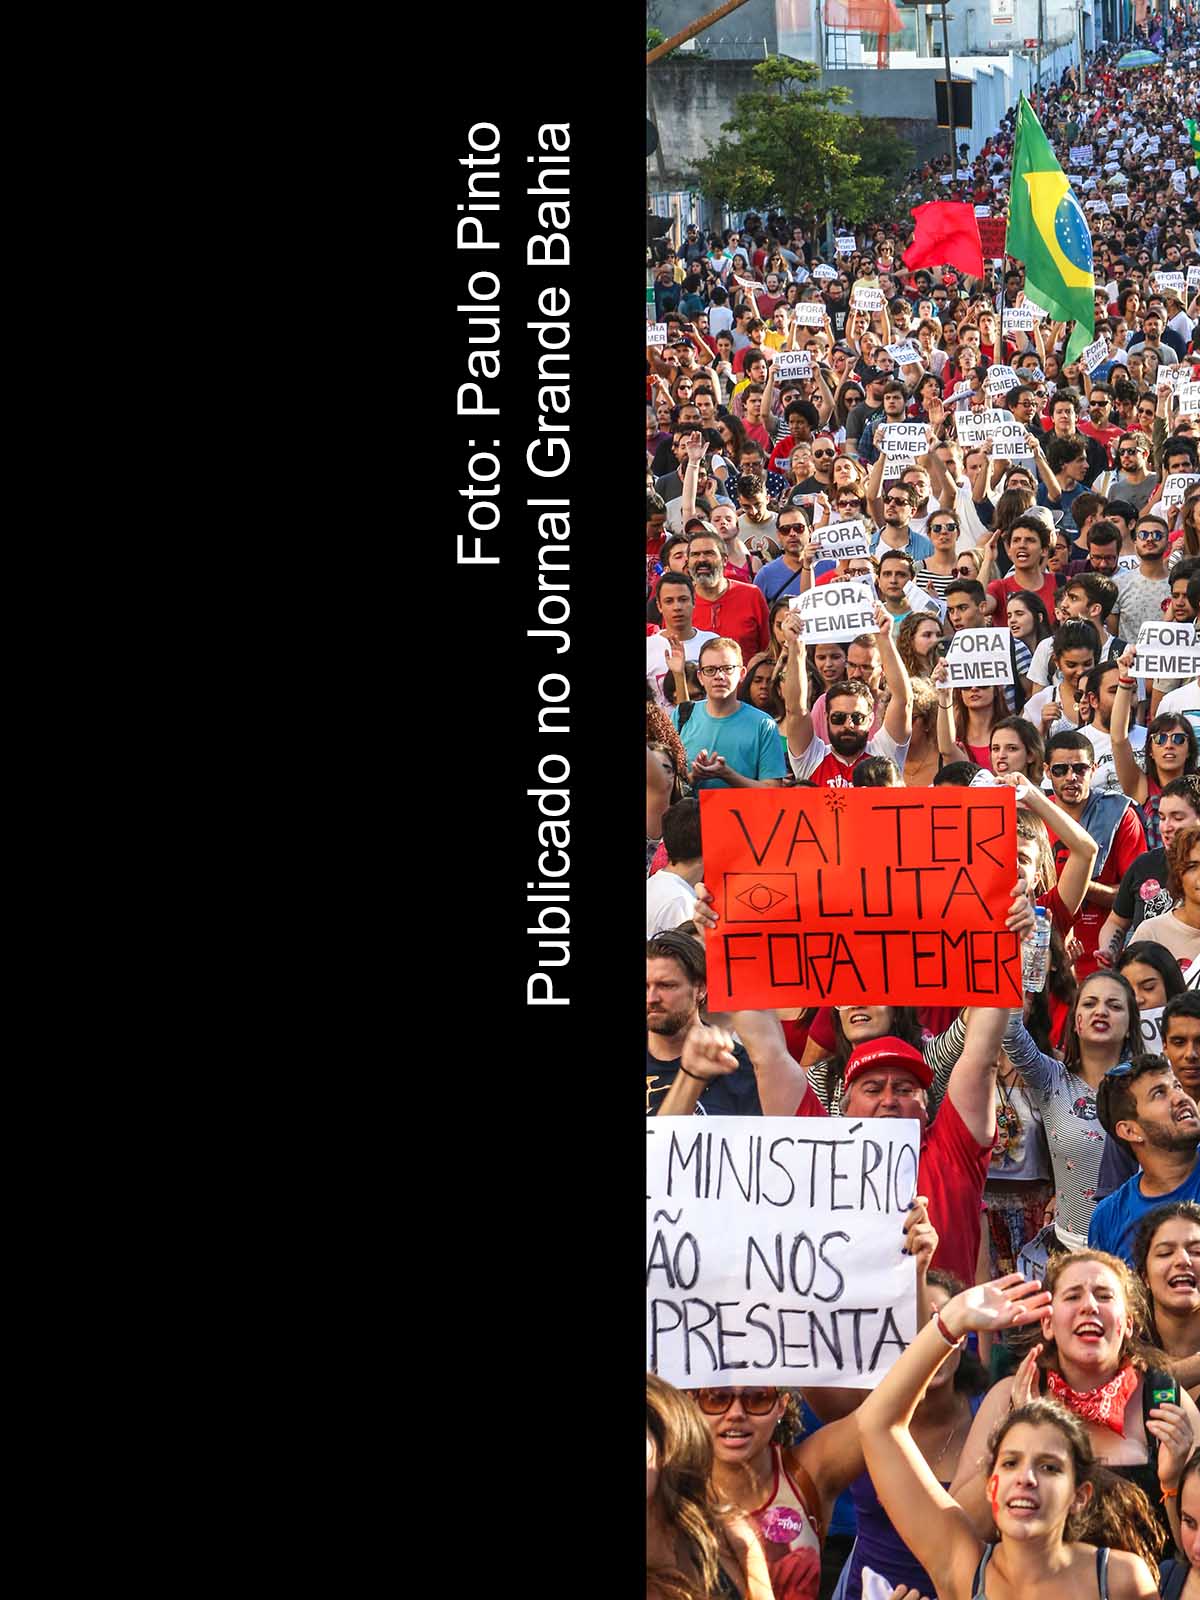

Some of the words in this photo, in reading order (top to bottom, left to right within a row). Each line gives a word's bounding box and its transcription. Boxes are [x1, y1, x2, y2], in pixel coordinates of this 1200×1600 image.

[1002, 320, 1032, 329] TEMER
[775, 353, 810, 364] #FORA
[988, 379, 1018, 392] TEMER
[958, 412, 1001, 425] #FORA
[880, 441, 927, 452] TEMER
[812, 525, 864, 545] #FORA
[814, 545, 867, 560] TEMER
[801, 588, 868, 610] #FORA
[800, 611, 875, 634] TEMER
[1137, 628, 1200, 646] #FORA
[945, 661, 1009, 681] EMER
[729, 800, 840, 867] VAI
[872, 804, 1005, 868] TER
[817, 866, 994, 921] LUTA
[667, 1121, 919, 1214] MINISTÉRIO
[746, 1230, 850, 1303] NOS
[651, 1298, 911, 1375] PRESENTA
